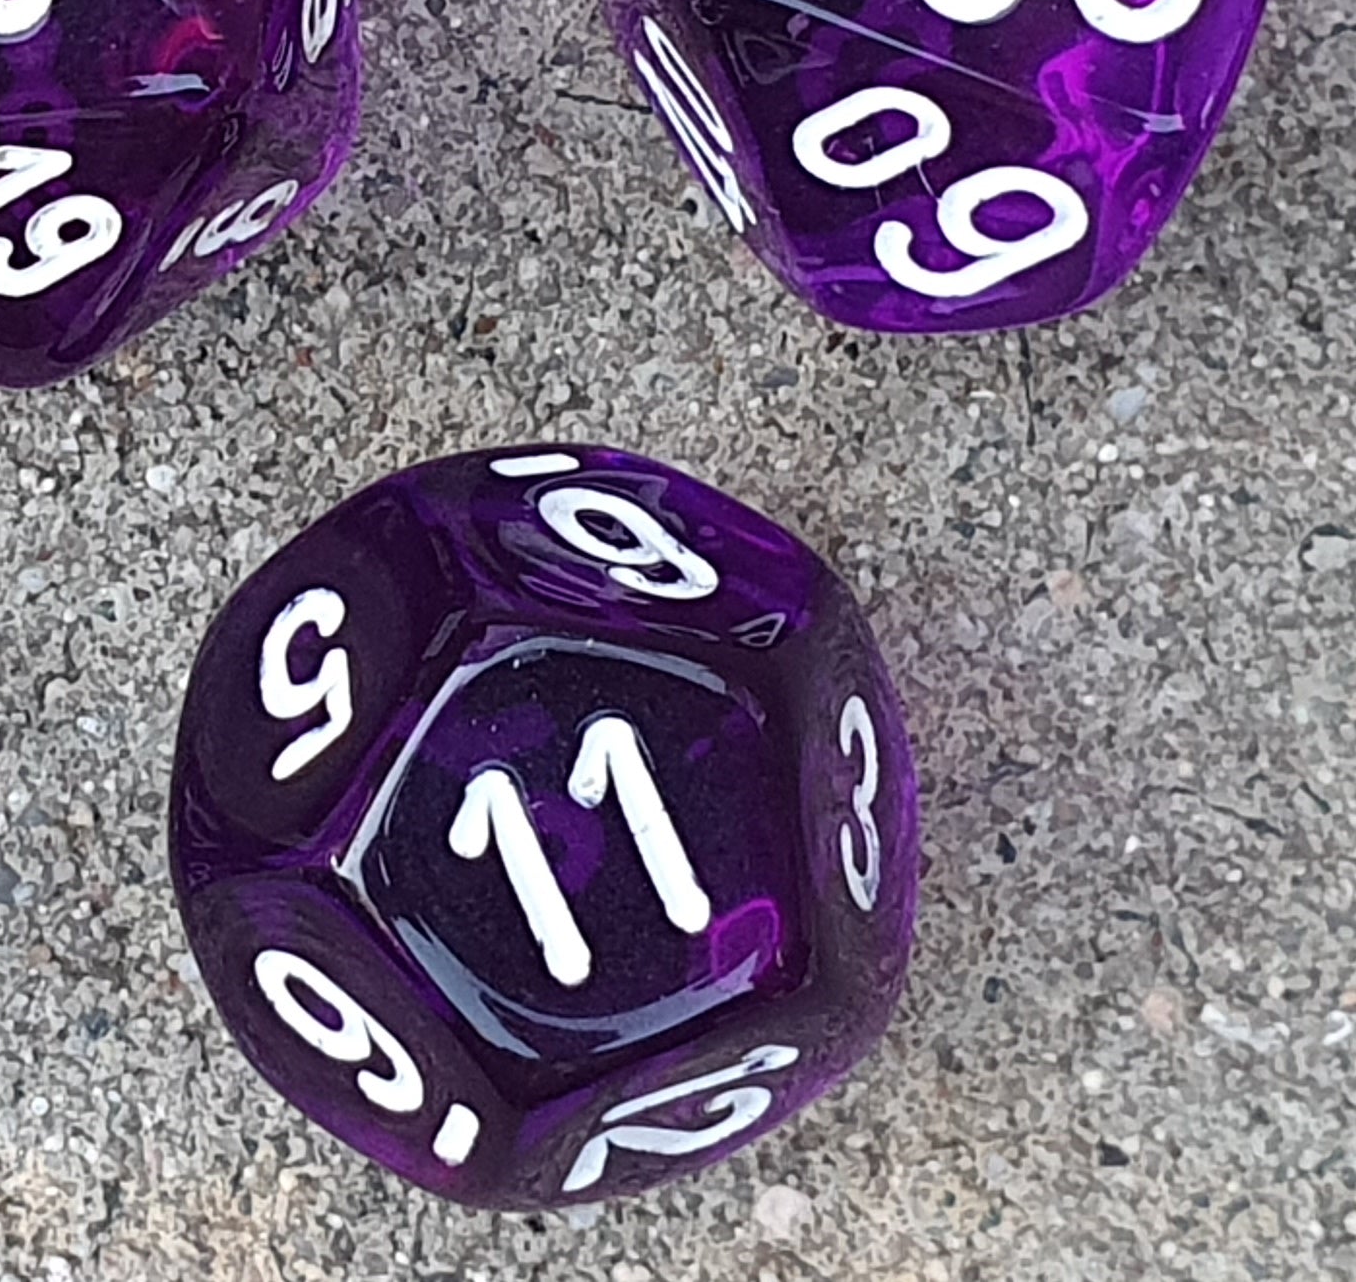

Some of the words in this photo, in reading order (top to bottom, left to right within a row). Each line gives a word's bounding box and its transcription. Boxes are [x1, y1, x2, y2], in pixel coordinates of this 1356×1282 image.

[260, 587, 353, 780] 5
[448, 716, 710, 986] 11
[840, 695, 879, 911] 3
[552, 1045, 799, 1192] 12
